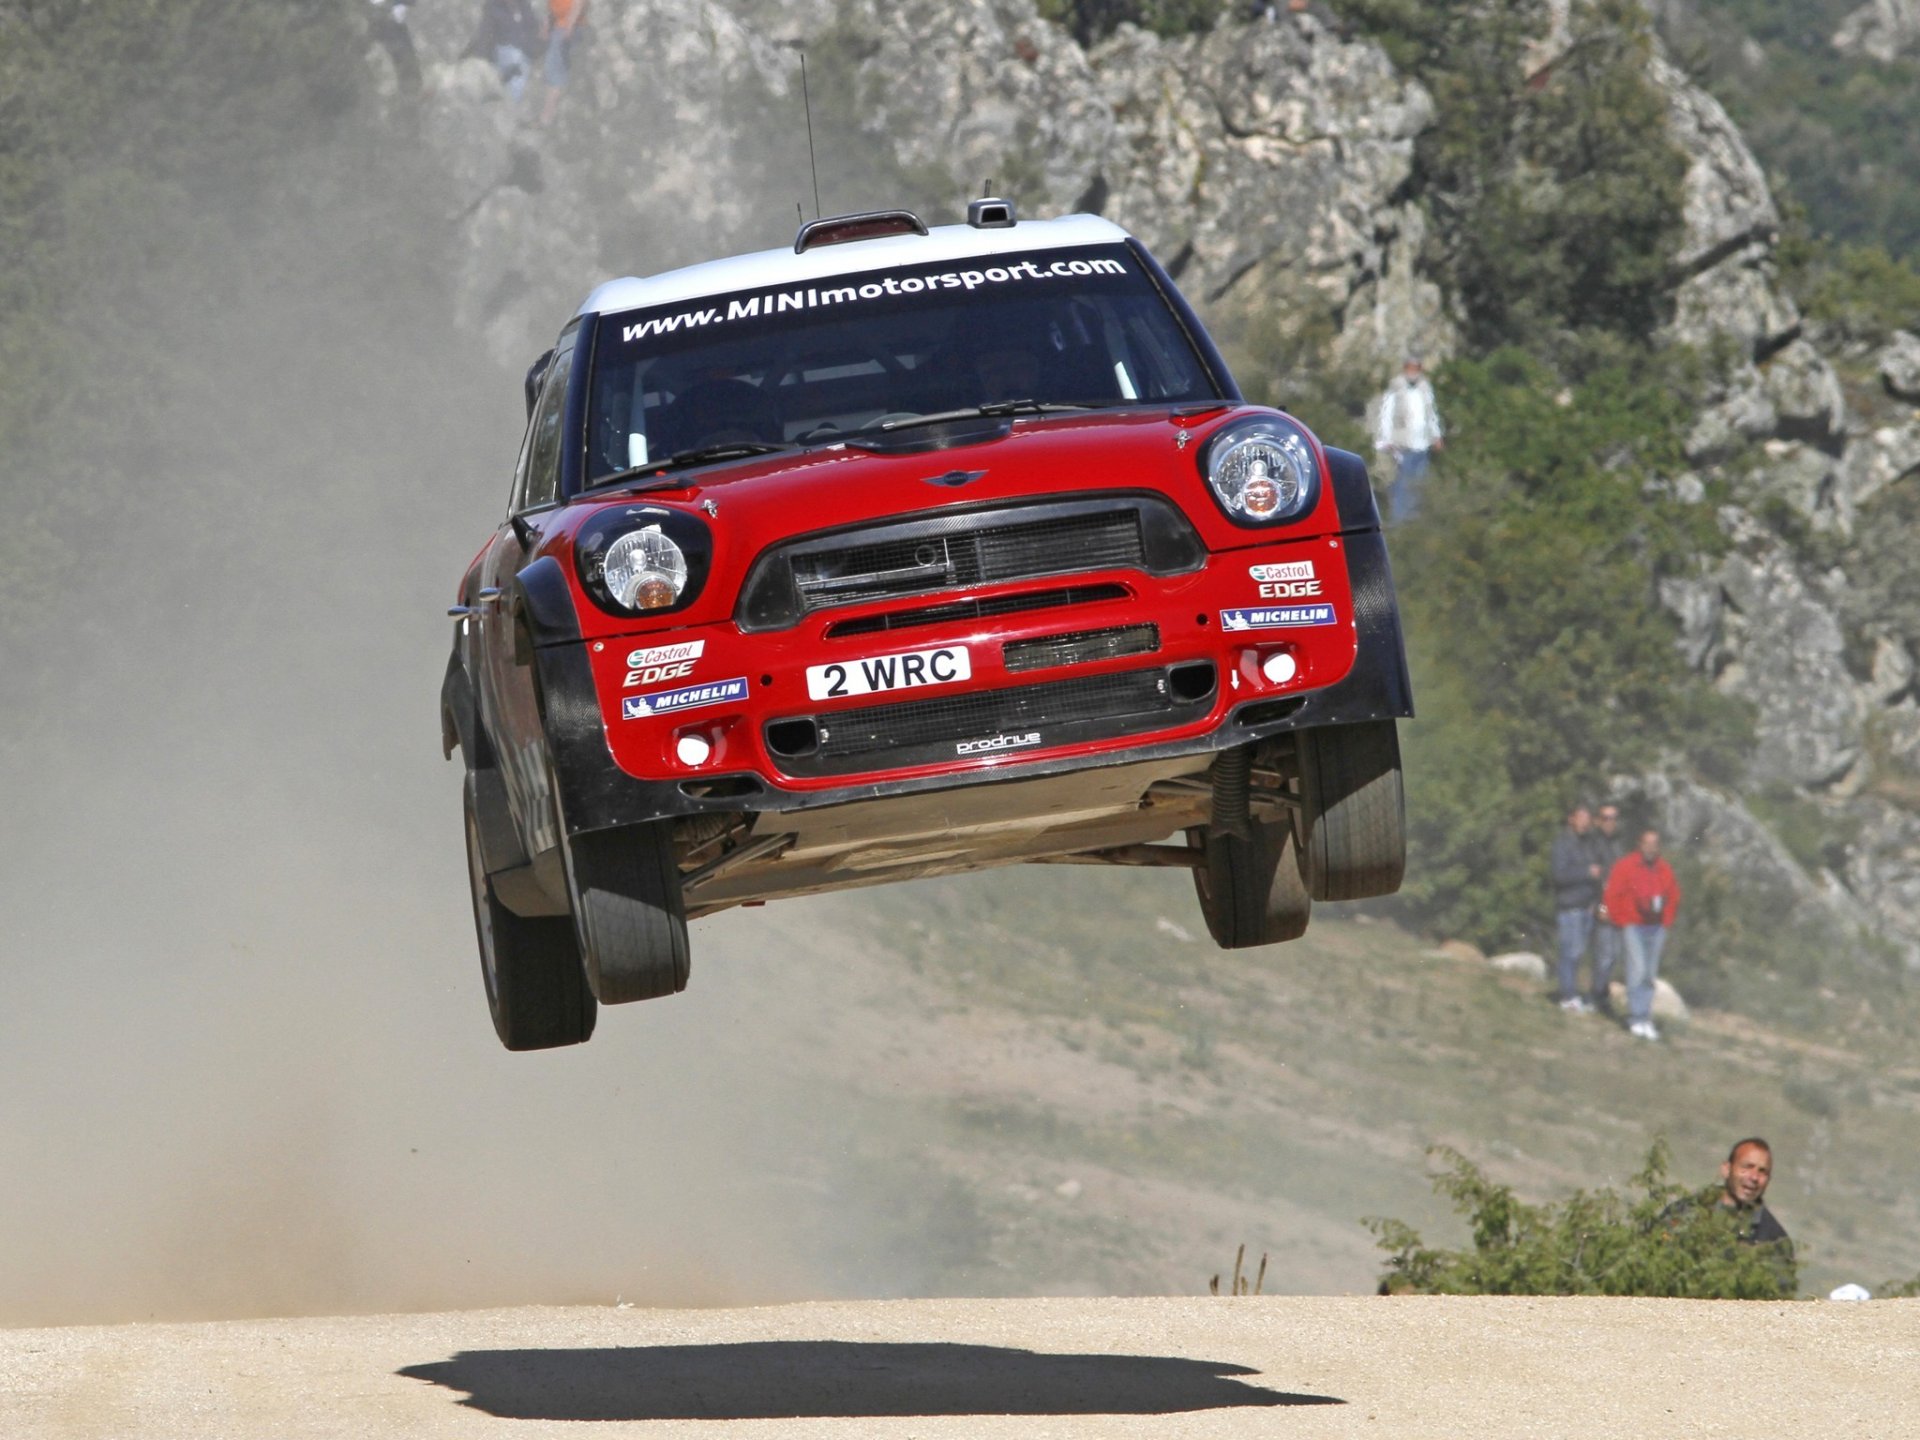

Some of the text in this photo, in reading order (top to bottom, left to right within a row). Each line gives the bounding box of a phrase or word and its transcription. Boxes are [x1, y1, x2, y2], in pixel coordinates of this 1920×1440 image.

[622, 255, 1127, 342] www.MINImotorsport.com
[1266, 562, 1310, 579] Castrol
[1258, 580, 1323, 598] EDGE
[1250, 608, 1328, 623] MICHELIN
[644, 644, 693, 664] Castrol
[622, 659, 697, 688] EDGE
[824, 650, 957, 697] 2 WRC
[655, 683, 741, 708] MICHELIN
[956, 732, 1041, 754] prodrive
